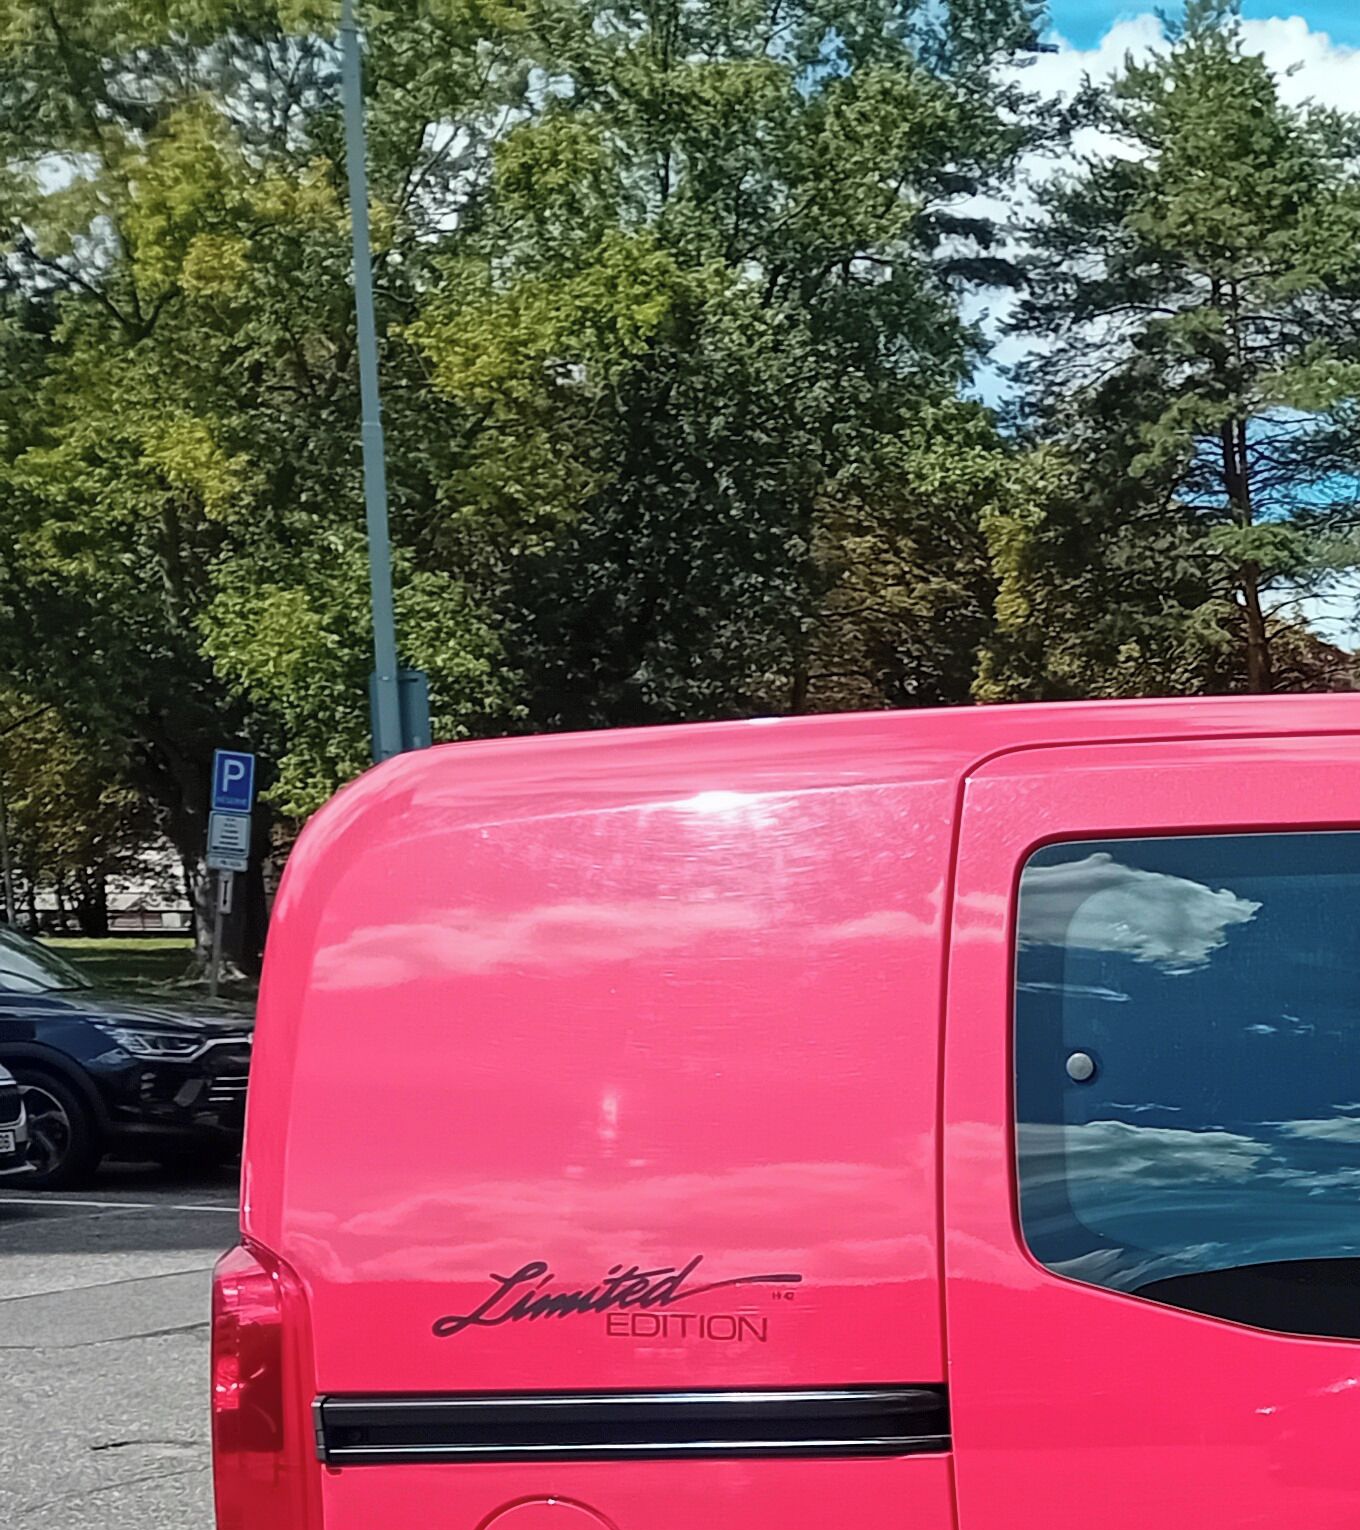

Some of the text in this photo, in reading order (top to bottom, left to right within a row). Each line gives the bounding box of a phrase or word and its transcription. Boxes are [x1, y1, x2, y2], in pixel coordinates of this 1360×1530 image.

[221, 759, 245, 793] P
[432, 1254, 803, 1338] Limited
[606, 1312, 769, 1343] EDITION
